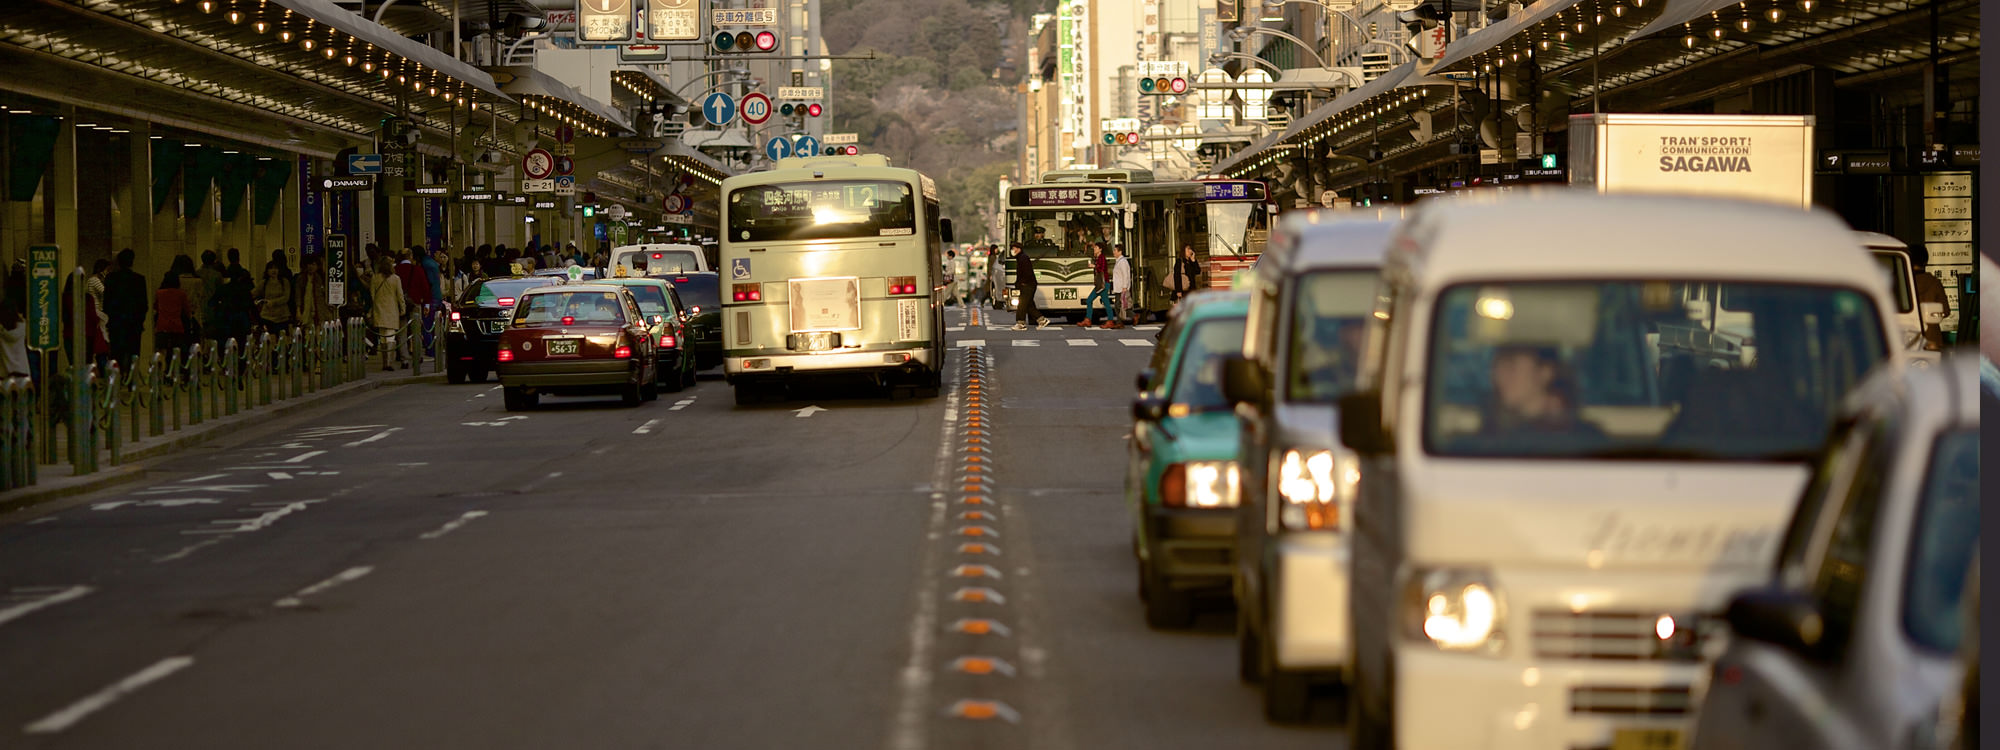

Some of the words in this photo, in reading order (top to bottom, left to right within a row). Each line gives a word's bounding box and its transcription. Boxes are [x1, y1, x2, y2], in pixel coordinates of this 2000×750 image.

[715, 11, 773, 22] 歩車分離信号
[1075, 20, 1084, 137] TAKASHIMAYA
[747, 101, 765, 116] 40
[1662, 146, 1749, 154] COMMUNICATION
[1659, 155, 1752, 172] SAGAWA
[333, 179, 368, 188] DAIMARU
[1048, 190, 1078, 200] 京都駅
[1082, 190, 1097, 202] 5
[328, 240, 344, 248] TAXI
[32, 250, 56, 262] TAXI
[555, 344, 577, 354] 56-37
